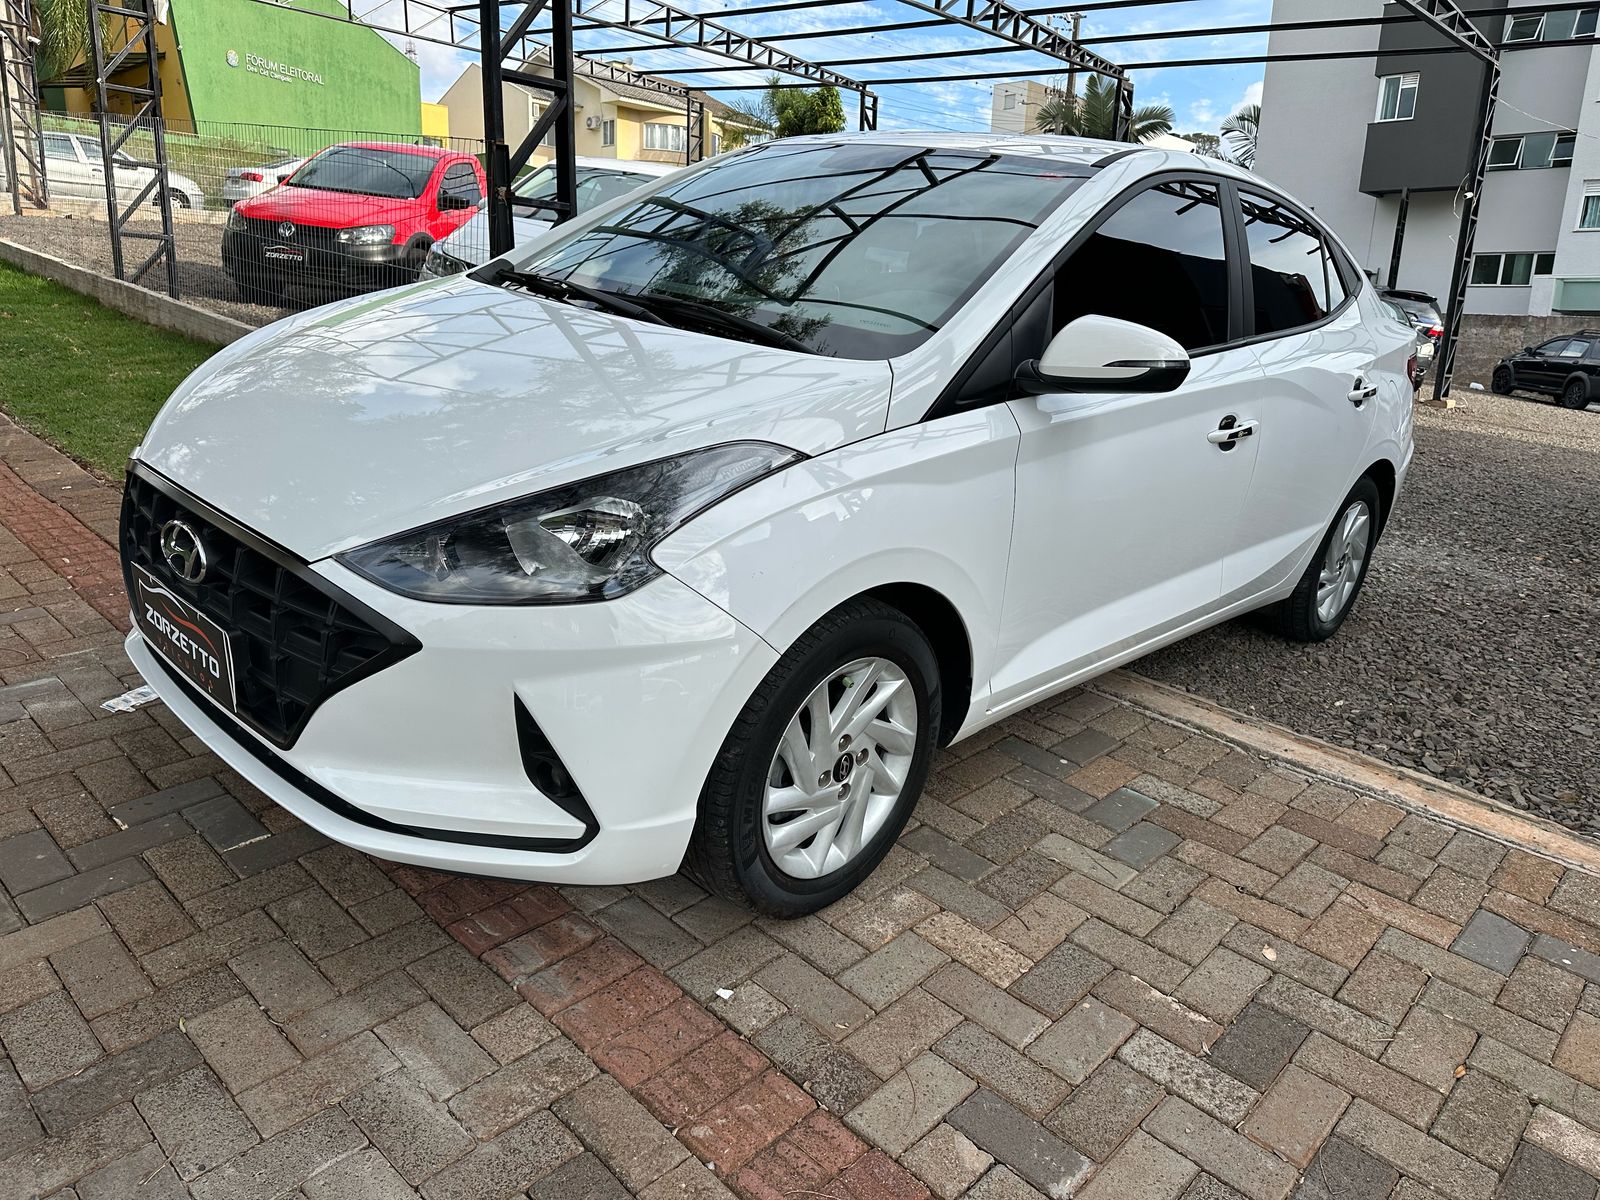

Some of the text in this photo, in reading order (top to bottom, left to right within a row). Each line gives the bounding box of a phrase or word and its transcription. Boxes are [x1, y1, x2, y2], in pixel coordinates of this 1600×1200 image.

[245, 53, 325, 85] FÓRUM ELEITORAL
[265, 251, 303, 261] ZORZETTO
[144, 602, 220, 679] ZORZETTO
